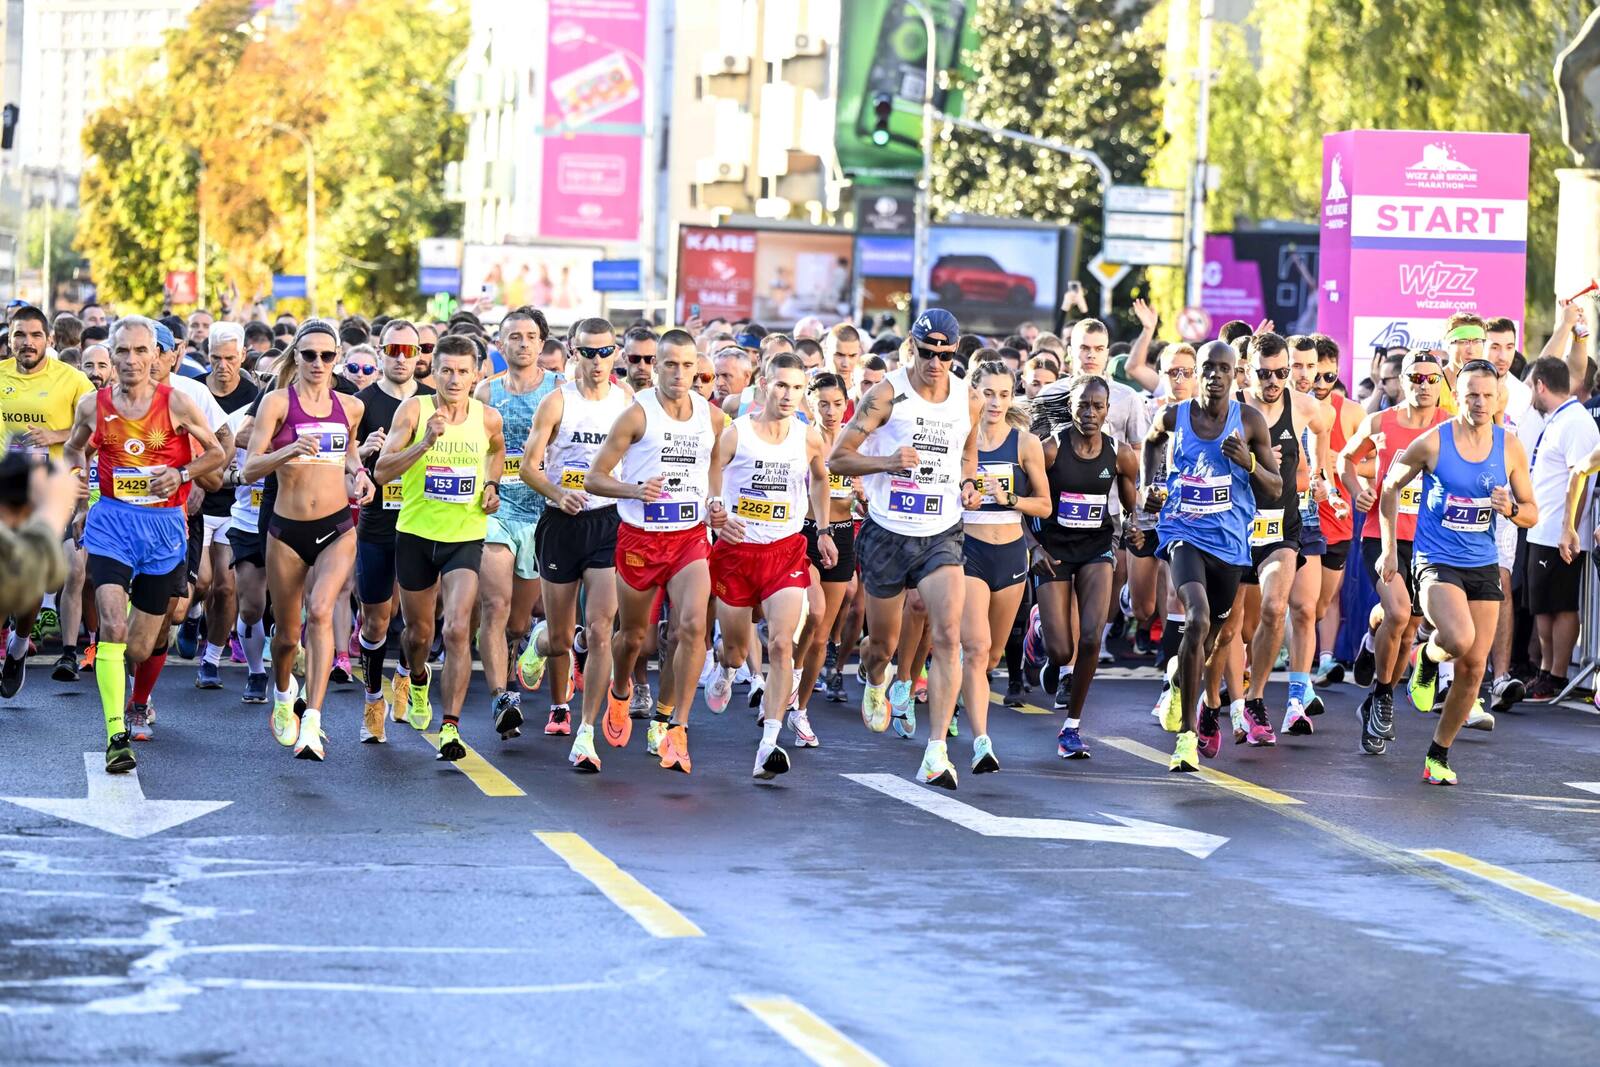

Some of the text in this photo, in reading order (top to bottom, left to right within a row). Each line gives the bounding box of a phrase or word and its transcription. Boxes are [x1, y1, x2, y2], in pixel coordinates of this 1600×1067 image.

[1405, 171, 1429, 180] WIZZ
[1430, 172, 1445, 181] AIR
[1417, 181, 1465, 189] MARATHON
[1376, 204, 1504, 234] START
[687, 233, 755, 252] KARE
[1416, 299, 1477, 311] wizzair.com
[2, 411, 47, 423] SKOBUL
[425, 455, 479, 465] MARATHON
[117, 480, 147, 490] 2429
[433, 478, 453, 489] 153
[1193, 489, 1201, 499] 2
[901, 494, 915, 507] 10
[659, 505, 665, 516] 1
[741, 501, 770, 514] 2262
[1071, 505, 1079, 515] 3
[1456, 508, 1469, 519] 71
